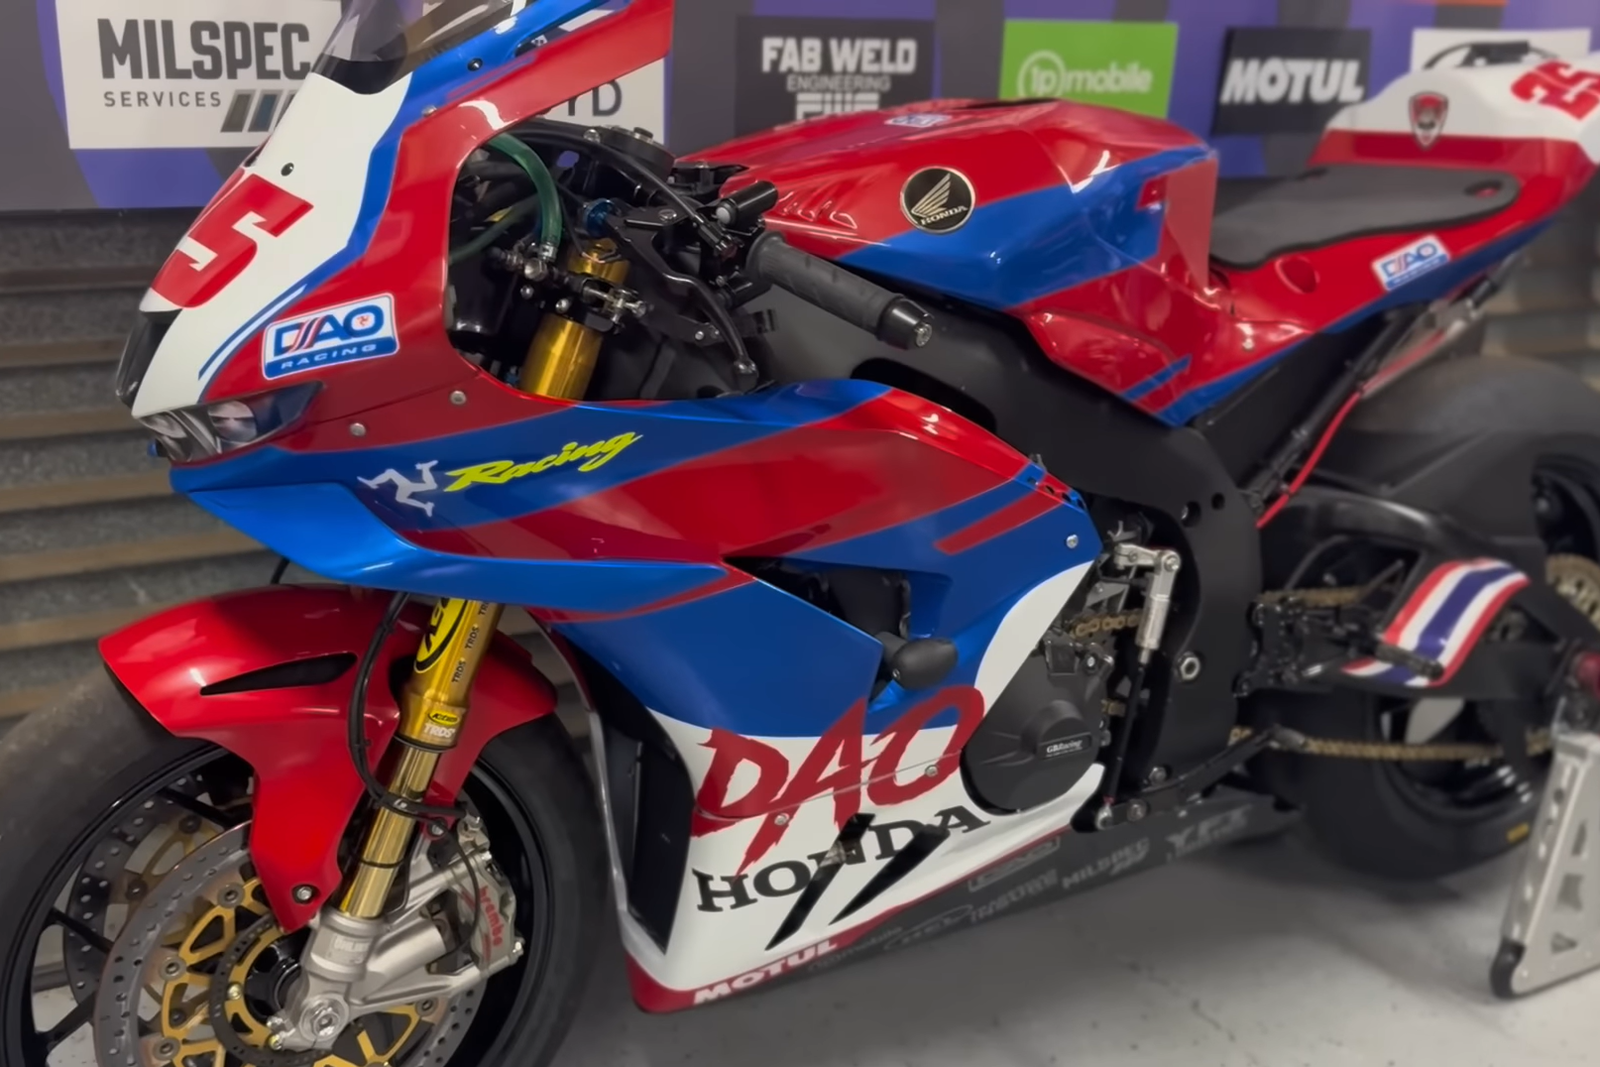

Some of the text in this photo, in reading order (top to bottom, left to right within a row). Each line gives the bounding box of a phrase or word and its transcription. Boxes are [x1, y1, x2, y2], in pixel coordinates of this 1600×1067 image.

[98, 18, 311, 80] MILSPEC
[762, 37, 917, 74] FAB WELD
[103, 91, 222, 107] SERVICES
[786, 75, 892, 92] ENGINEERING
[1220, 57, 1365, 104] MOTUL
[920, 205, 969, 226] HONDA
[273, 305, 385, 358] DAO
[280, 344, 377, 370] RACING
[443, 432, 644, 492] Racing
[691, 685, 985, 881] DAO
[693, 939, 838, 1005] MOTUL
